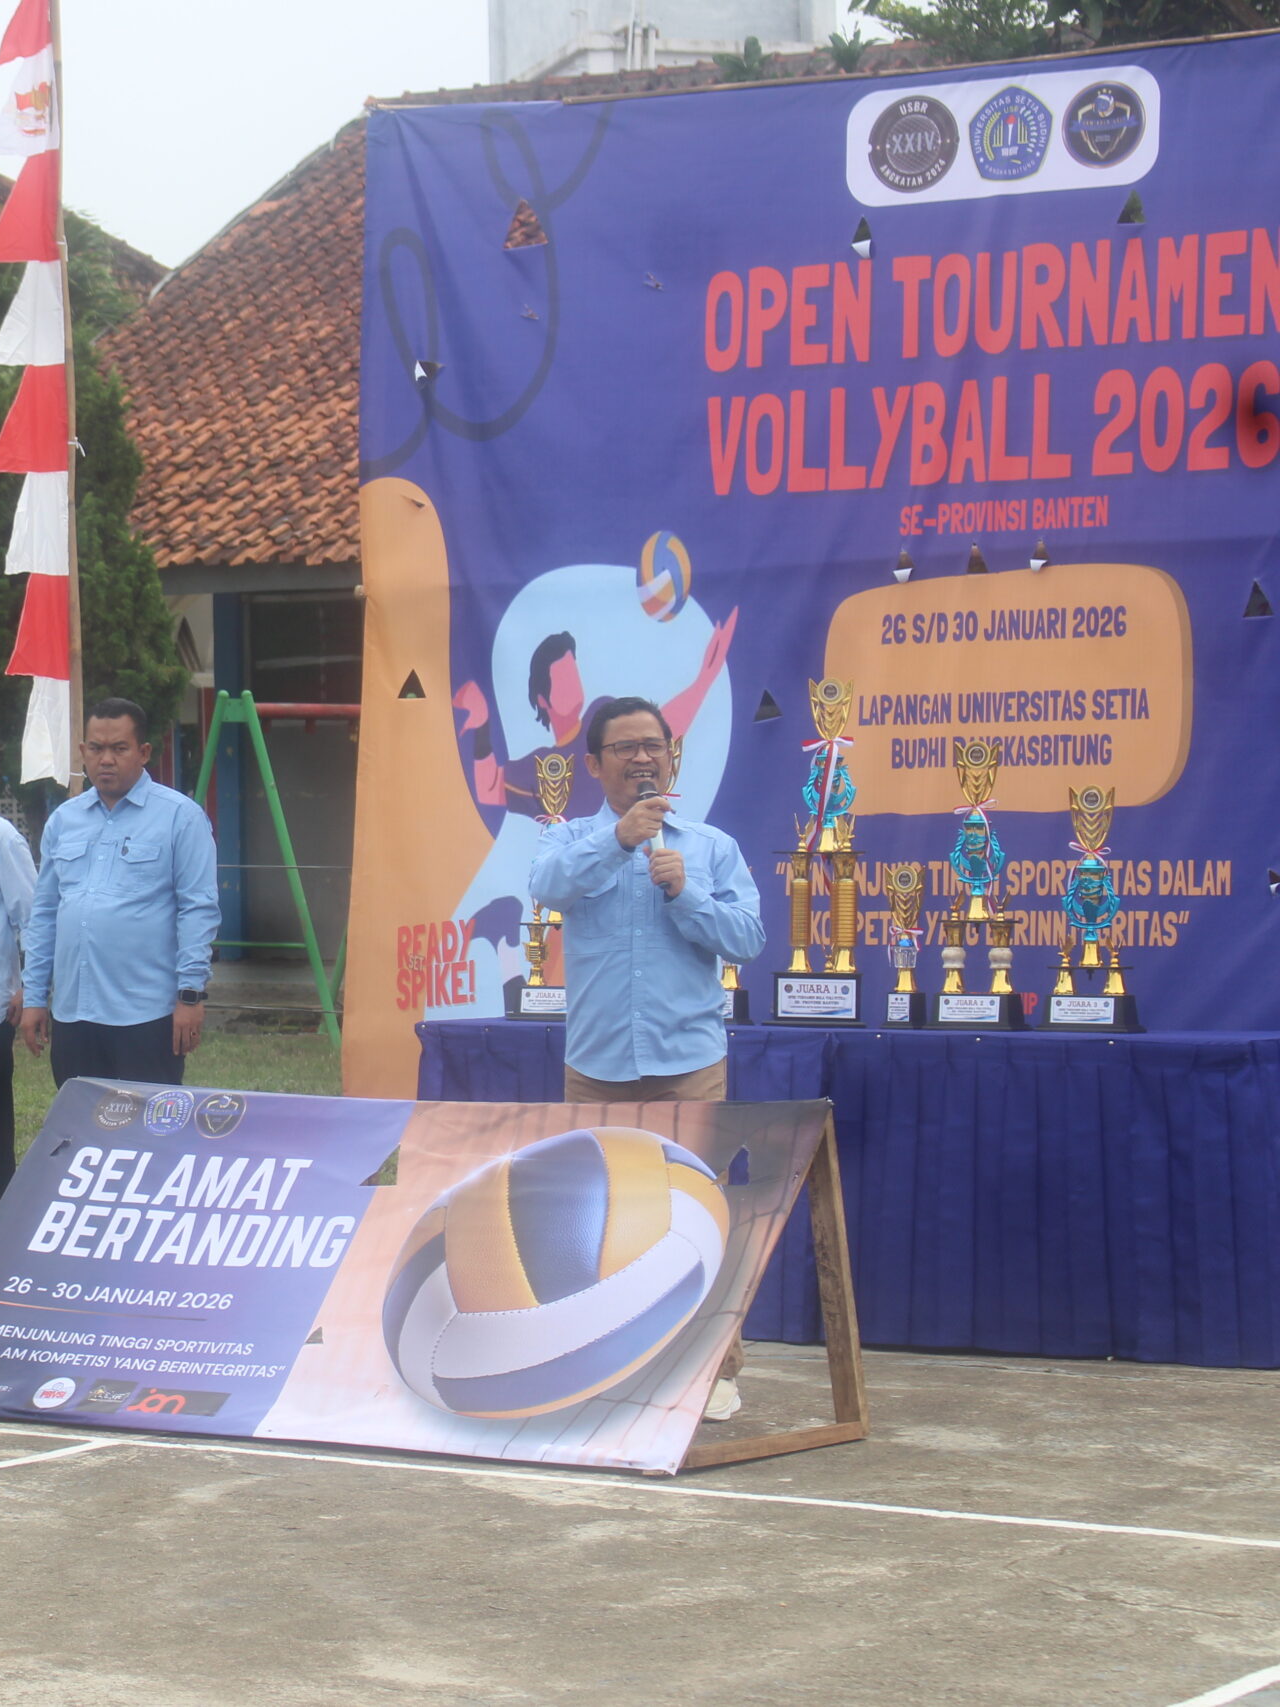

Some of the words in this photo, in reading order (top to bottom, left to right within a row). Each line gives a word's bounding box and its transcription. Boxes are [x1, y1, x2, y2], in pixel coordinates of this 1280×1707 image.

[899, 100, 929, 115] USBR
[892, 131, 935, 154] XXIV
[880, 164, 923, 187] ANGKATAN
[926, 158, 946, 181] 2024
[705, 260, 872, 372] OPEN
[707, 373, 1072, 496] VOLLYBALL
[1091, 360, 1280, 477] 2026
[899, 500, 1027, 536] SE-PROVINSI
[1032, 496, 1109, 531] BANTEN
[881, 613, 907, 645] 26
[912, 612, 948, 644] S/D
[953, 610, 978, 642] 30
[984, 608, 1067, 641] JANUARI
[1072, 605, 1127, 638] 2026
[858, 692, 952, 726] LAPANGAN
[958, 690, 1086, 723] UNIVERSITAS
[1091, 688, 1150, 720] SETIA
[891, 736, 946, 769] BUDHI
[953, 733, 1112, 767] RGKASBITUNG
[1158, 859, 1231, 896] DALAM
[397, 919, 476, 969] READY
[925, 910, 980, 946] YAG
[396, 959, 476, 1011] SPIKE!
[796, 984, 830, 993] JUARA
[834, 985, 838, 994] 1
[58, 1146, 314, 1211] SELAMAT
[27, 1201, 356, 1268] BERTANDING
[3, 1276, 33, 1294] 26
[52, 1282, 83, 1300] 30
[84, 1286, 177, 1308] JANUARI
[177, 1292, 234, 1310] 2026
[28, 1349, 111, 1368] KOMPETISI
[113, 1357, 157, 1371] YANG
[99, 1334, 153, 1350] TINGGI
[154, 1338, 254, 1356] SPORTIVITAS
